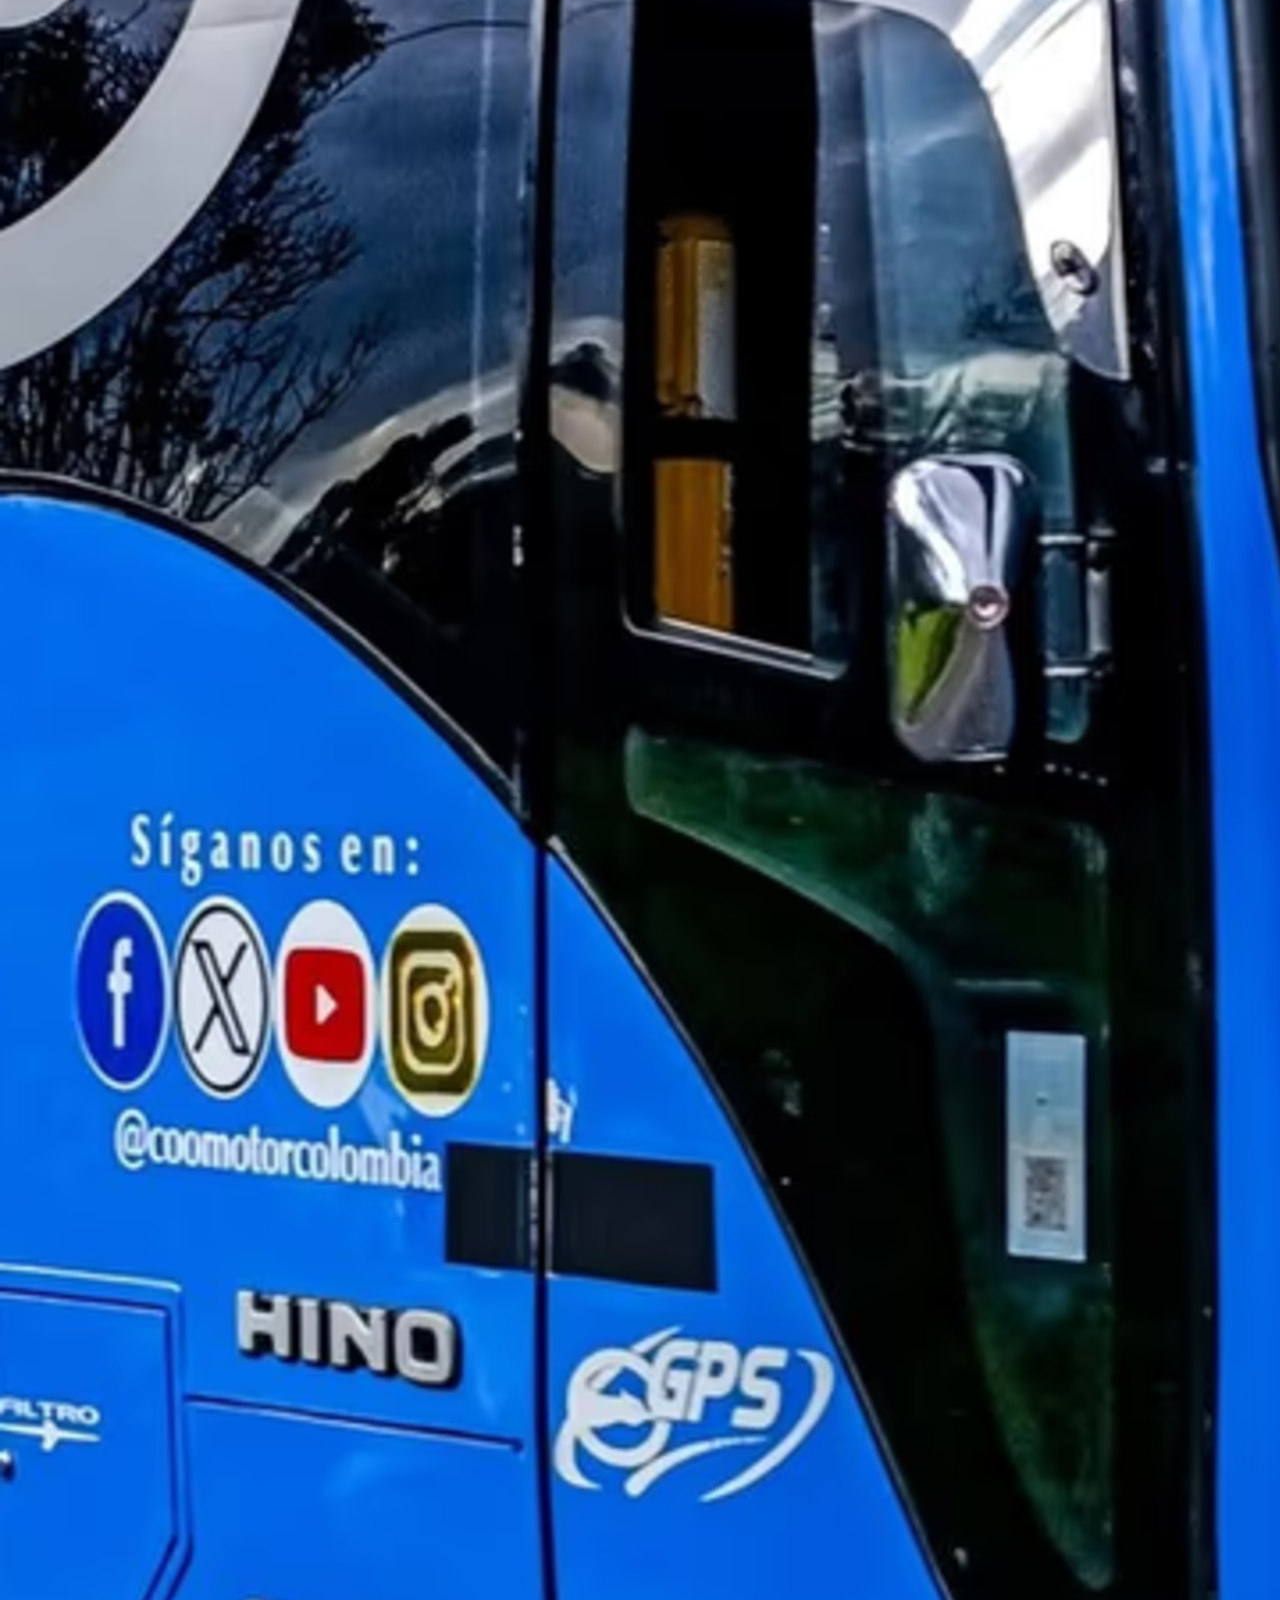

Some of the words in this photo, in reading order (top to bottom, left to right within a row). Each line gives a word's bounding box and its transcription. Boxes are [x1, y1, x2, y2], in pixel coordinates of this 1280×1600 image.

[131, 812, 321, 884] Síganos
[340, 833, 420, 876] en:
[114, 1108, 442, 1193] @coomotorcolombia
[236, 1288, 461, 1387] HINO
[648, 1338, 788, 1430] GPS
